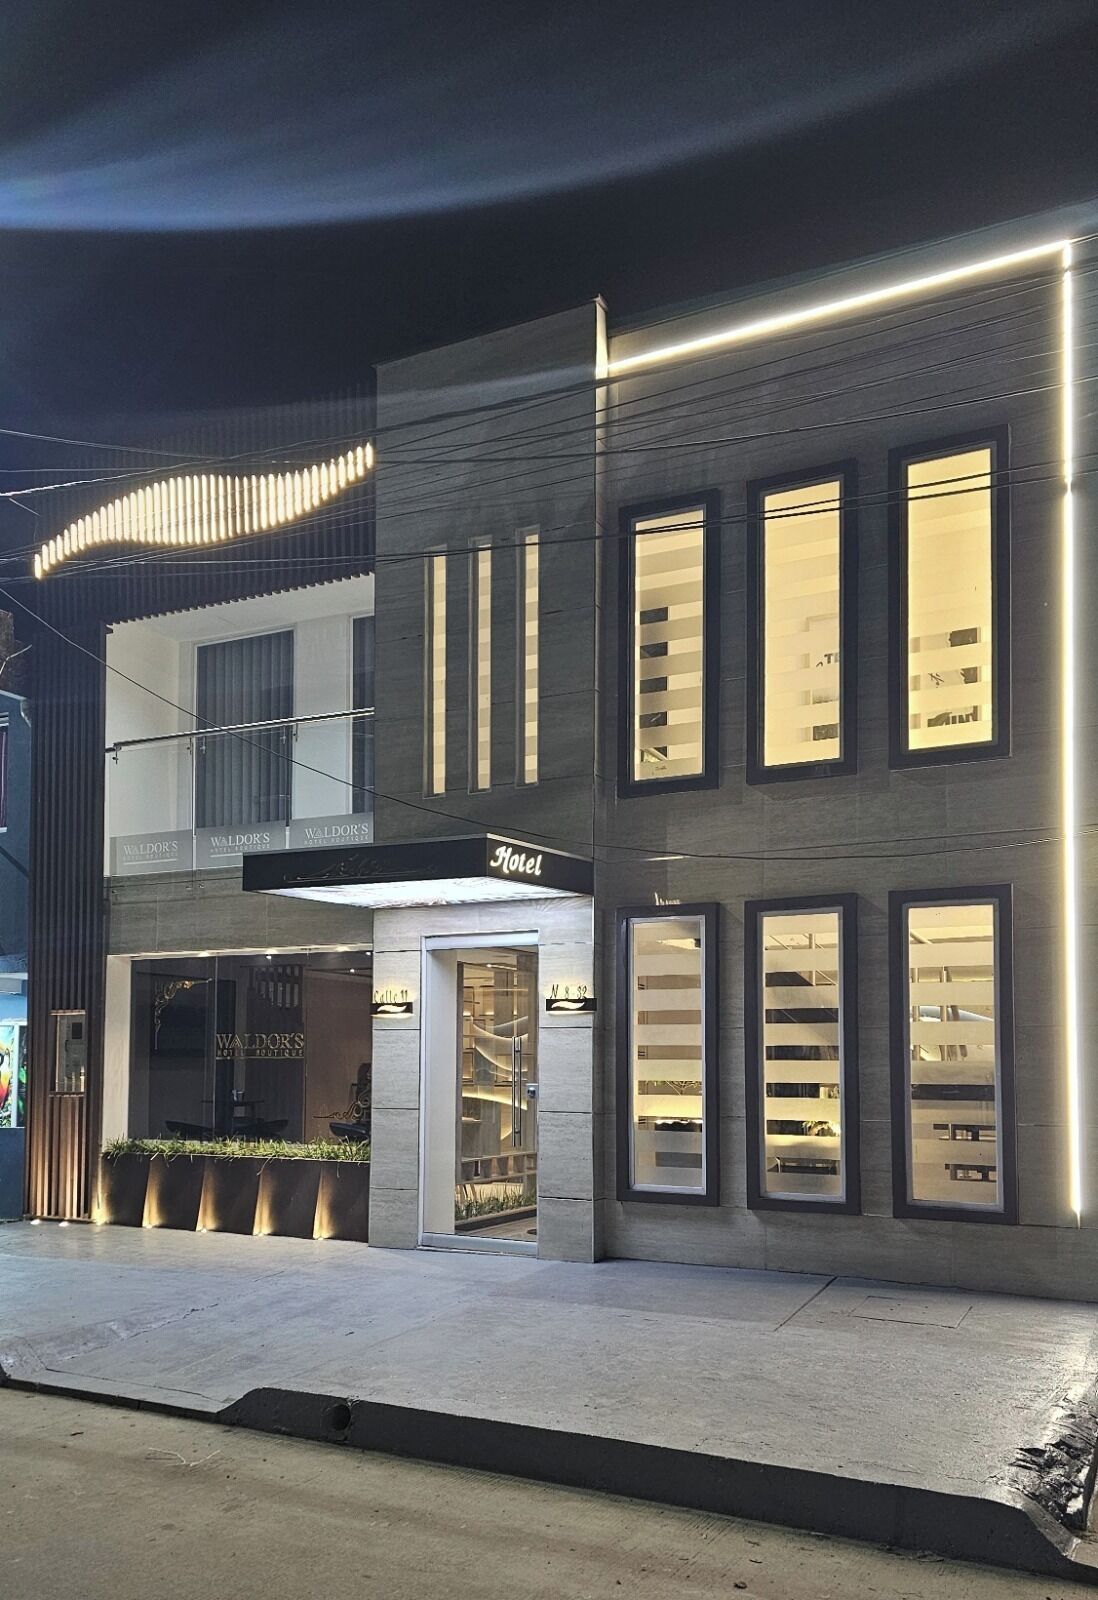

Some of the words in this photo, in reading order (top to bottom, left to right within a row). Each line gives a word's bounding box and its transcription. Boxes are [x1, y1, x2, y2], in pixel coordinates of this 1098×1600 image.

[210, 832, 271, 847] WALDOR'S
[304, 823, 369, 840] WALDOR'S
[489, 845, 543, 876] Hotel
[216, 1033, 305, 1050] WALDOR'S
